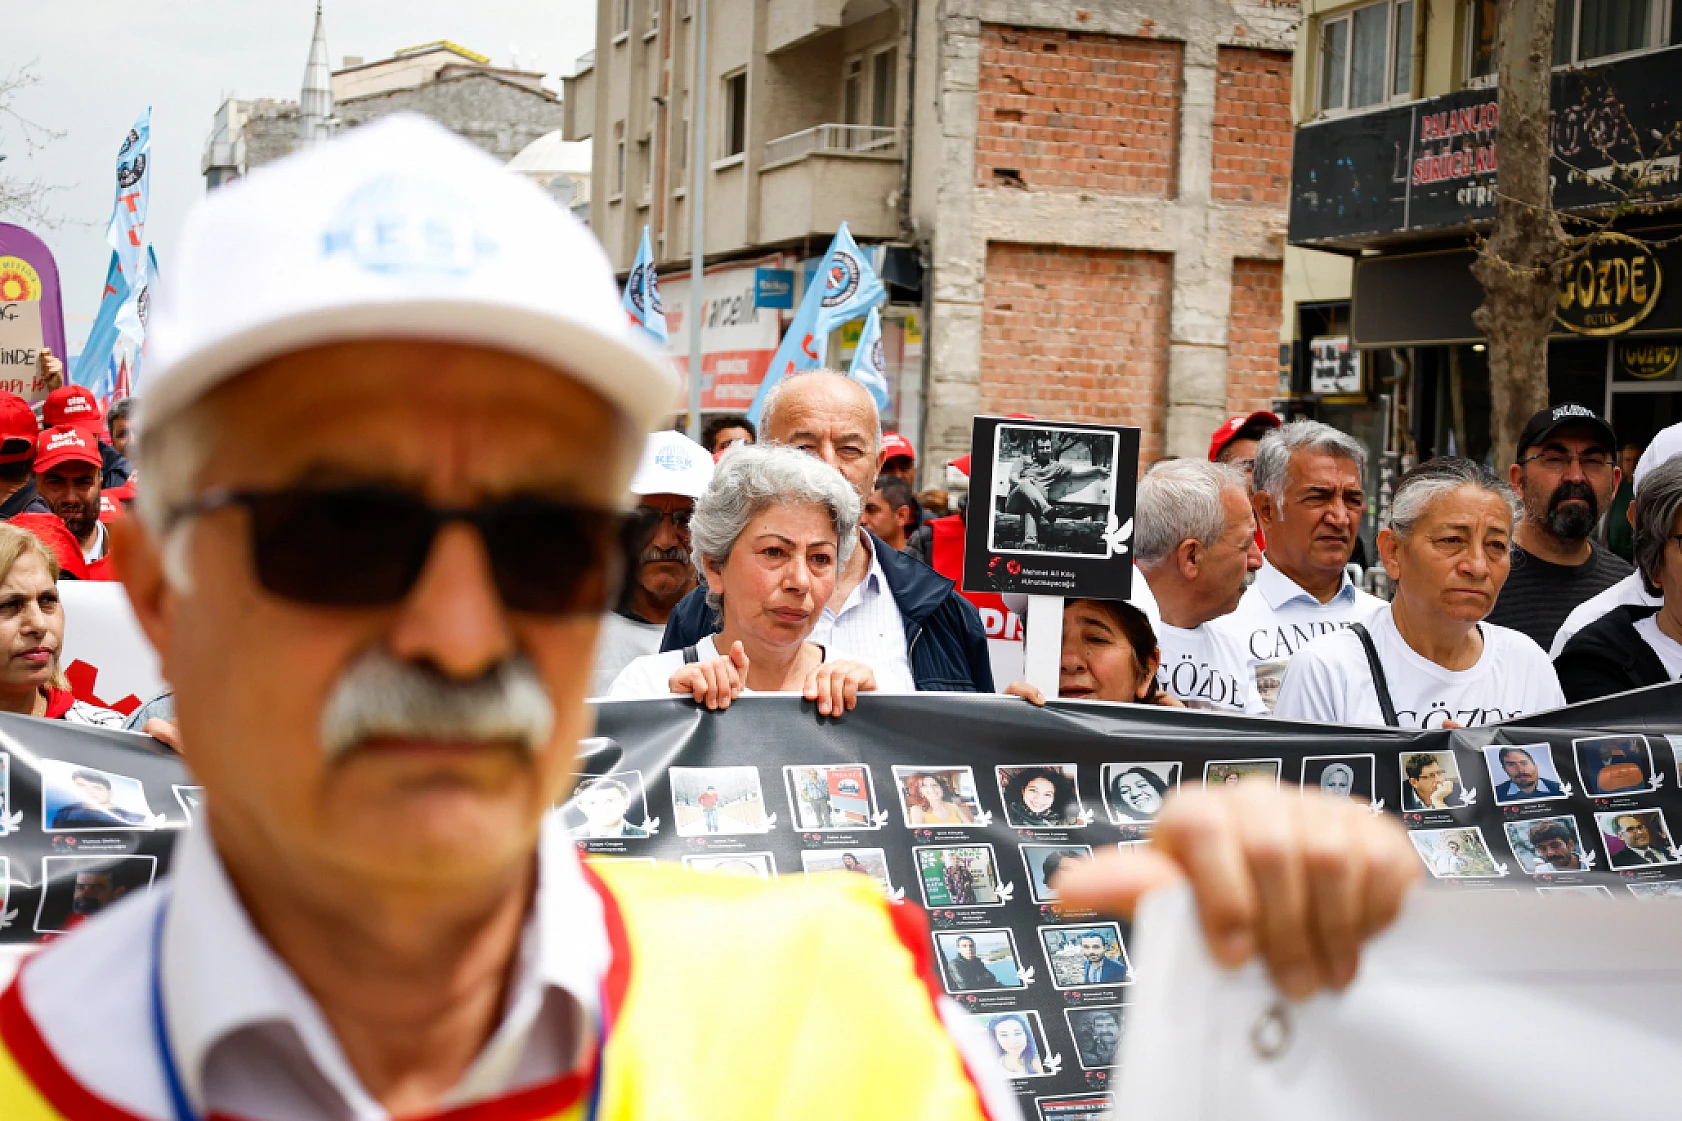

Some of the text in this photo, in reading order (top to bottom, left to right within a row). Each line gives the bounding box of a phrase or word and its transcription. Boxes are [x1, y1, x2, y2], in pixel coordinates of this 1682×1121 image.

[1421, 102, 1498, 142] PALANCIO
[1475, 143, 1497, 174] KU
[654, 454, 692, 468] KESK
